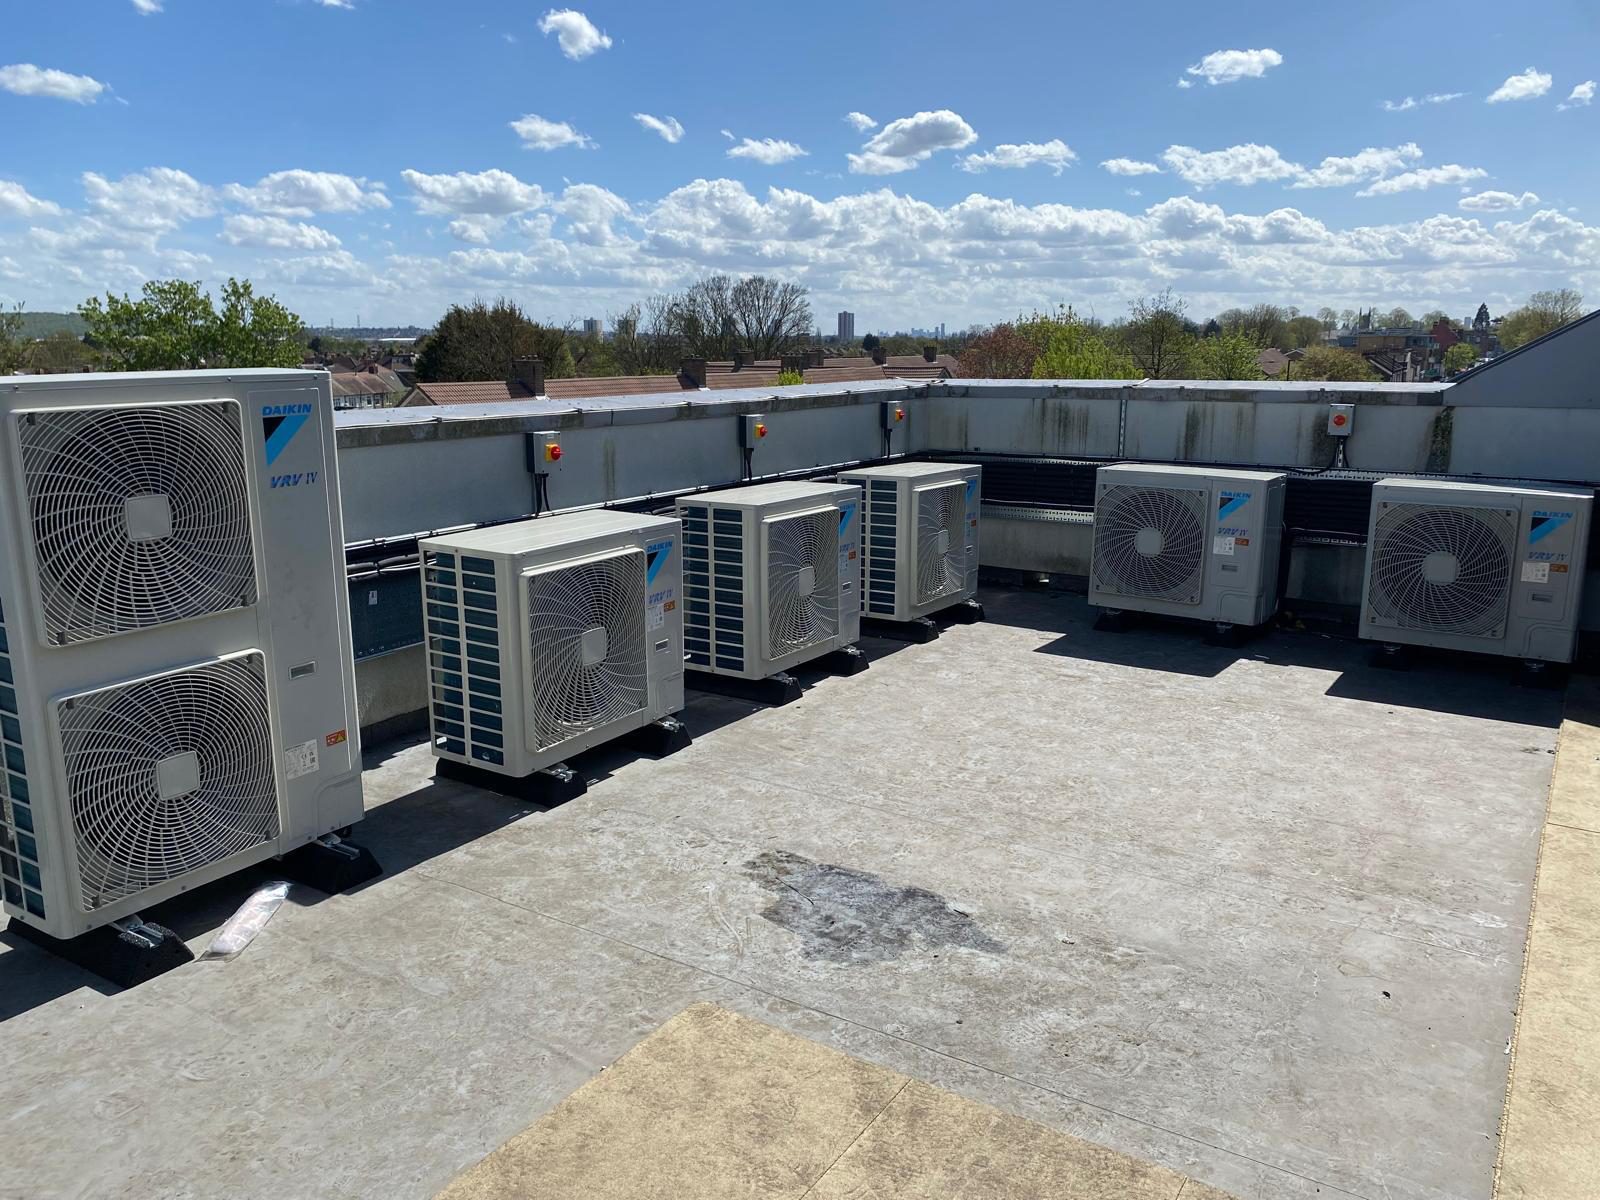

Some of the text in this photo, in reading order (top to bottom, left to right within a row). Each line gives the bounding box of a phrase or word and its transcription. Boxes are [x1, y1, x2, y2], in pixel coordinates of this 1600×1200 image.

[262, 403, 312, 416] DAIKIN
[270, 471, 318, 488] VRV IV
